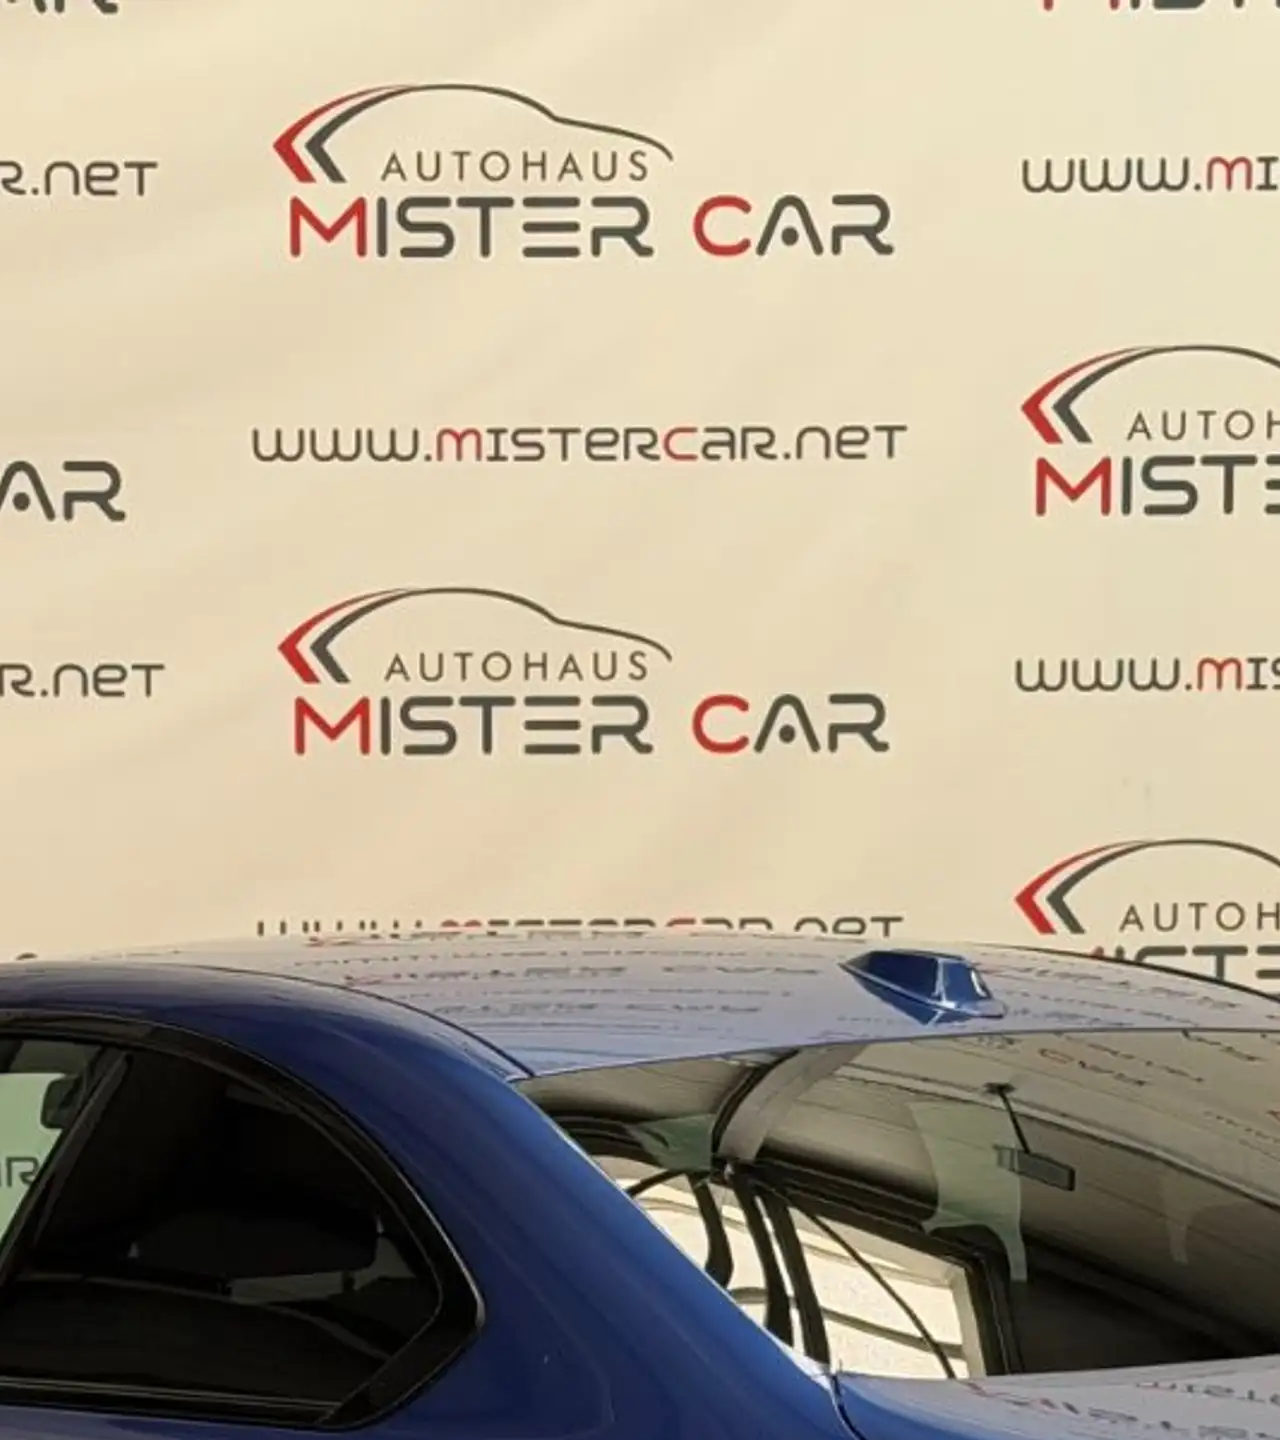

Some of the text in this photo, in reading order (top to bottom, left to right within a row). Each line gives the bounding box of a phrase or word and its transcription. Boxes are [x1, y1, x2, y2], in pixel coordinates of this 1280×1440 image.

[380, 149, 648, 182] AUTOHAUS
[289, 194, 895, 258] MISTER CAR
[383, 650, 648, 683] AUTOHAUS
[294, 693, 890, 756] MISTER CAR
